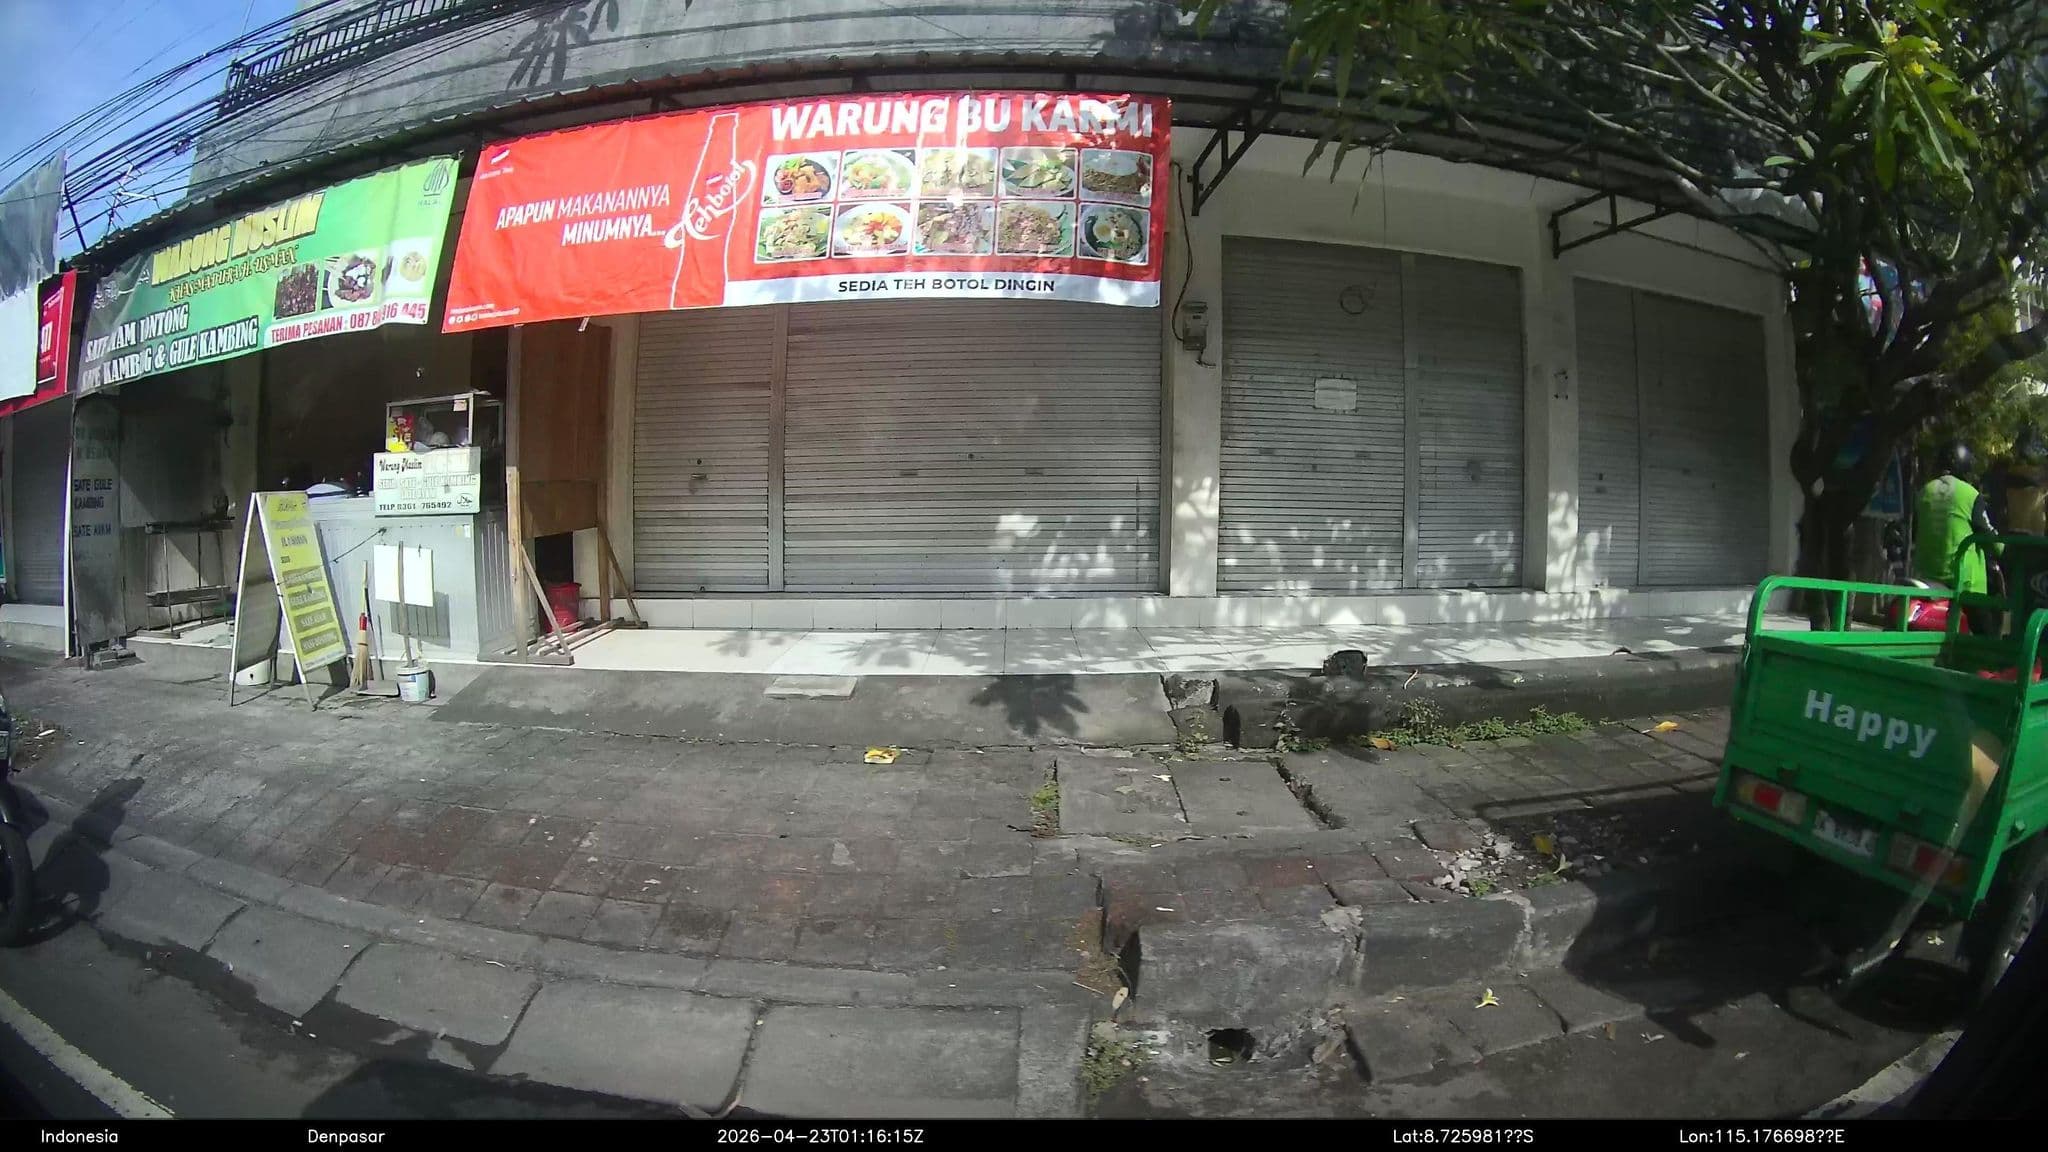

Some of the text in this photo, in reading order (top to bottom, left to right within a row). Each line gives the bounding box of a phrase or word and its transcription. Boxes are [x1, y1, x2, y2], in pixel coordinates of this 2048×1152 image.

[771, 97, 950, 142] WARUNG
[955, 98, 1011, 133] BU
[495, 184, 671, 231] APAPUN MAKANANNYA
[839, 278, 1055, 293] SEDIA TEH BOTOL DINGIN
[154, 343, 167, 369] &
[169, 335, 197, 366] GULE
[198, 317, 259, 358] KAMBING
[271, 324, 301, 344] TERIMA
[303, 315, 343, 337] PESANAN
[350, 312, 370, 329] 087
[1804, 689, 1937, 759] Happy
